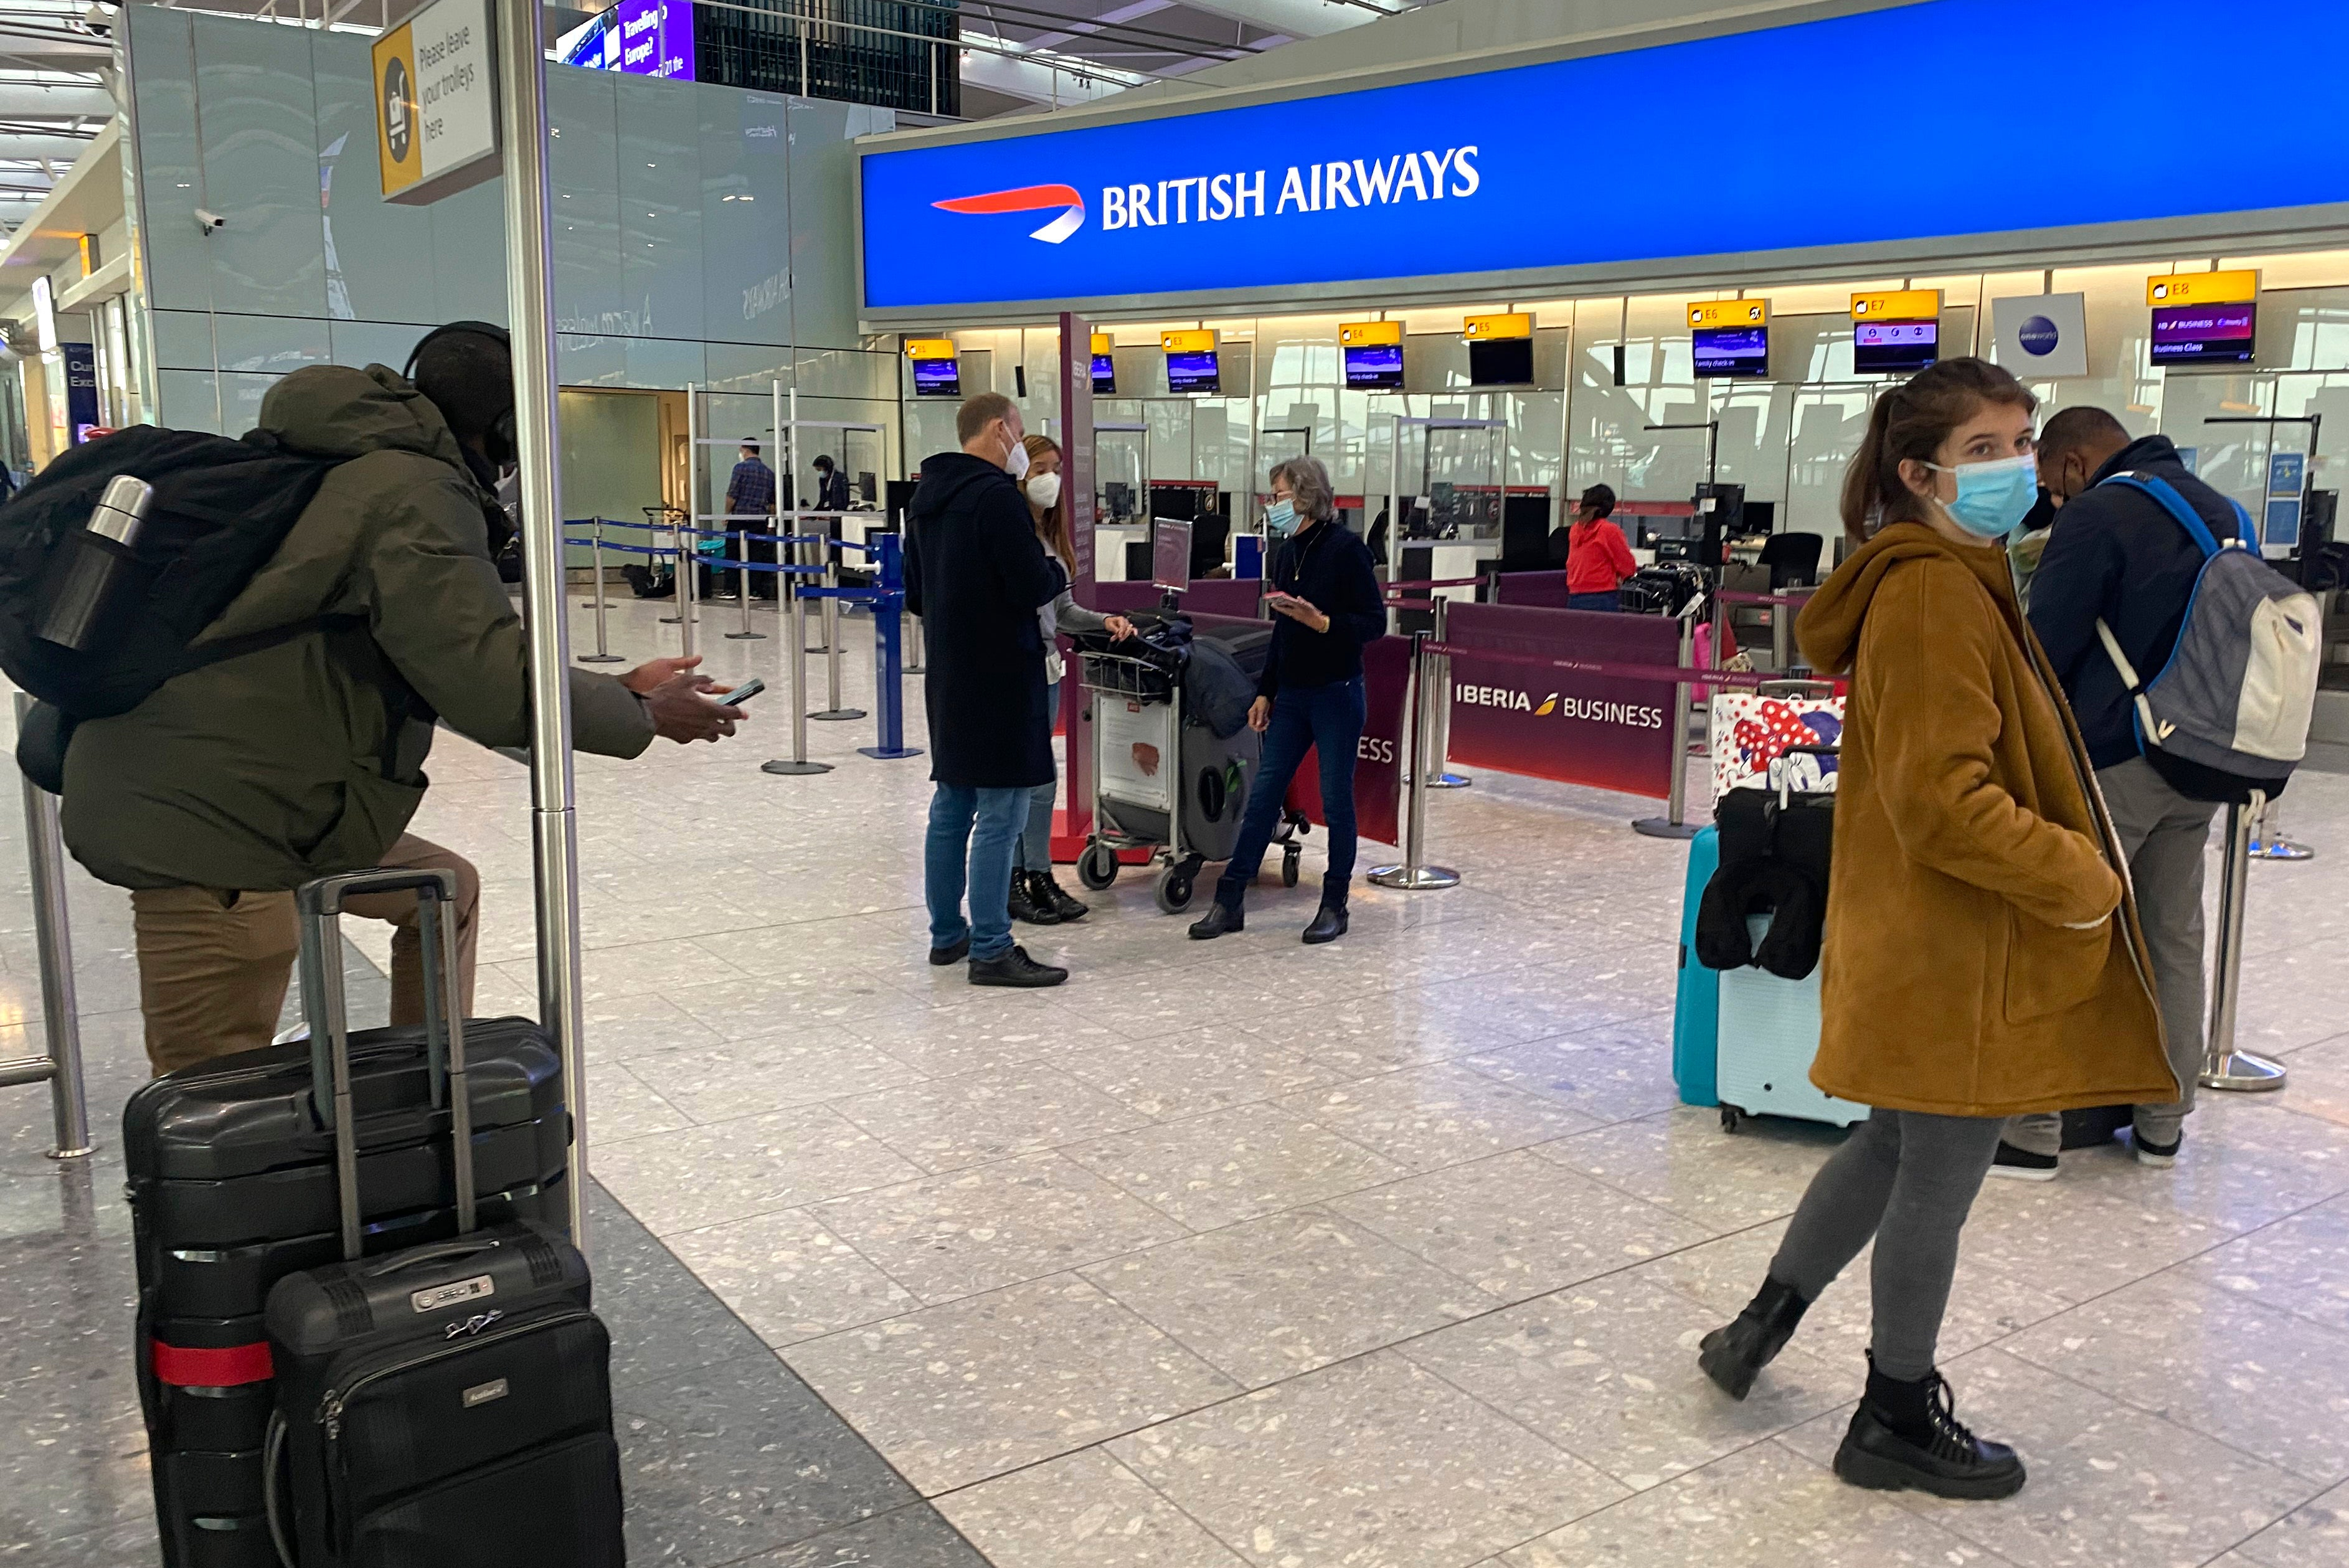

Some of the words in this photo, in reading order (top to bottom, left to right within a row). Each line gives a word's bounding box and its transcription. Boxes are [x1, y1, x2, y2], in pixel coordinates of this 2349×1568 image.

[623, 9, 658, 39] Travelling
[419, 41, 445, 72] Please
[446, 26, 470, 56] leave
[625, 36, 654, 65] Europe?
[422, 81, 442, 114] your
[442, 63, 475, 96] trolleys
[424, 118, 443, 143] here
[1102, 169, 1265, 231] BRITISH
[1275, 145, 1480, 215] AIRWAYS
[2172, 283, 2190, 295] E8
[1705, 308, 1718, 319] E6
[1871, 300, 1884, 311] E7
[1479, 322, 1490, 331] E5
[2178, 319, 2213, 329] BUSINESS
[1353, 329, 1364, 338] E4
[2153, 344, 2183, 353] Business
[2184, 342, 2203, 352] Class
[1455, 683, 1531, 712] IBERIA
[1563, 697, 1663, 729] BUSINESS
